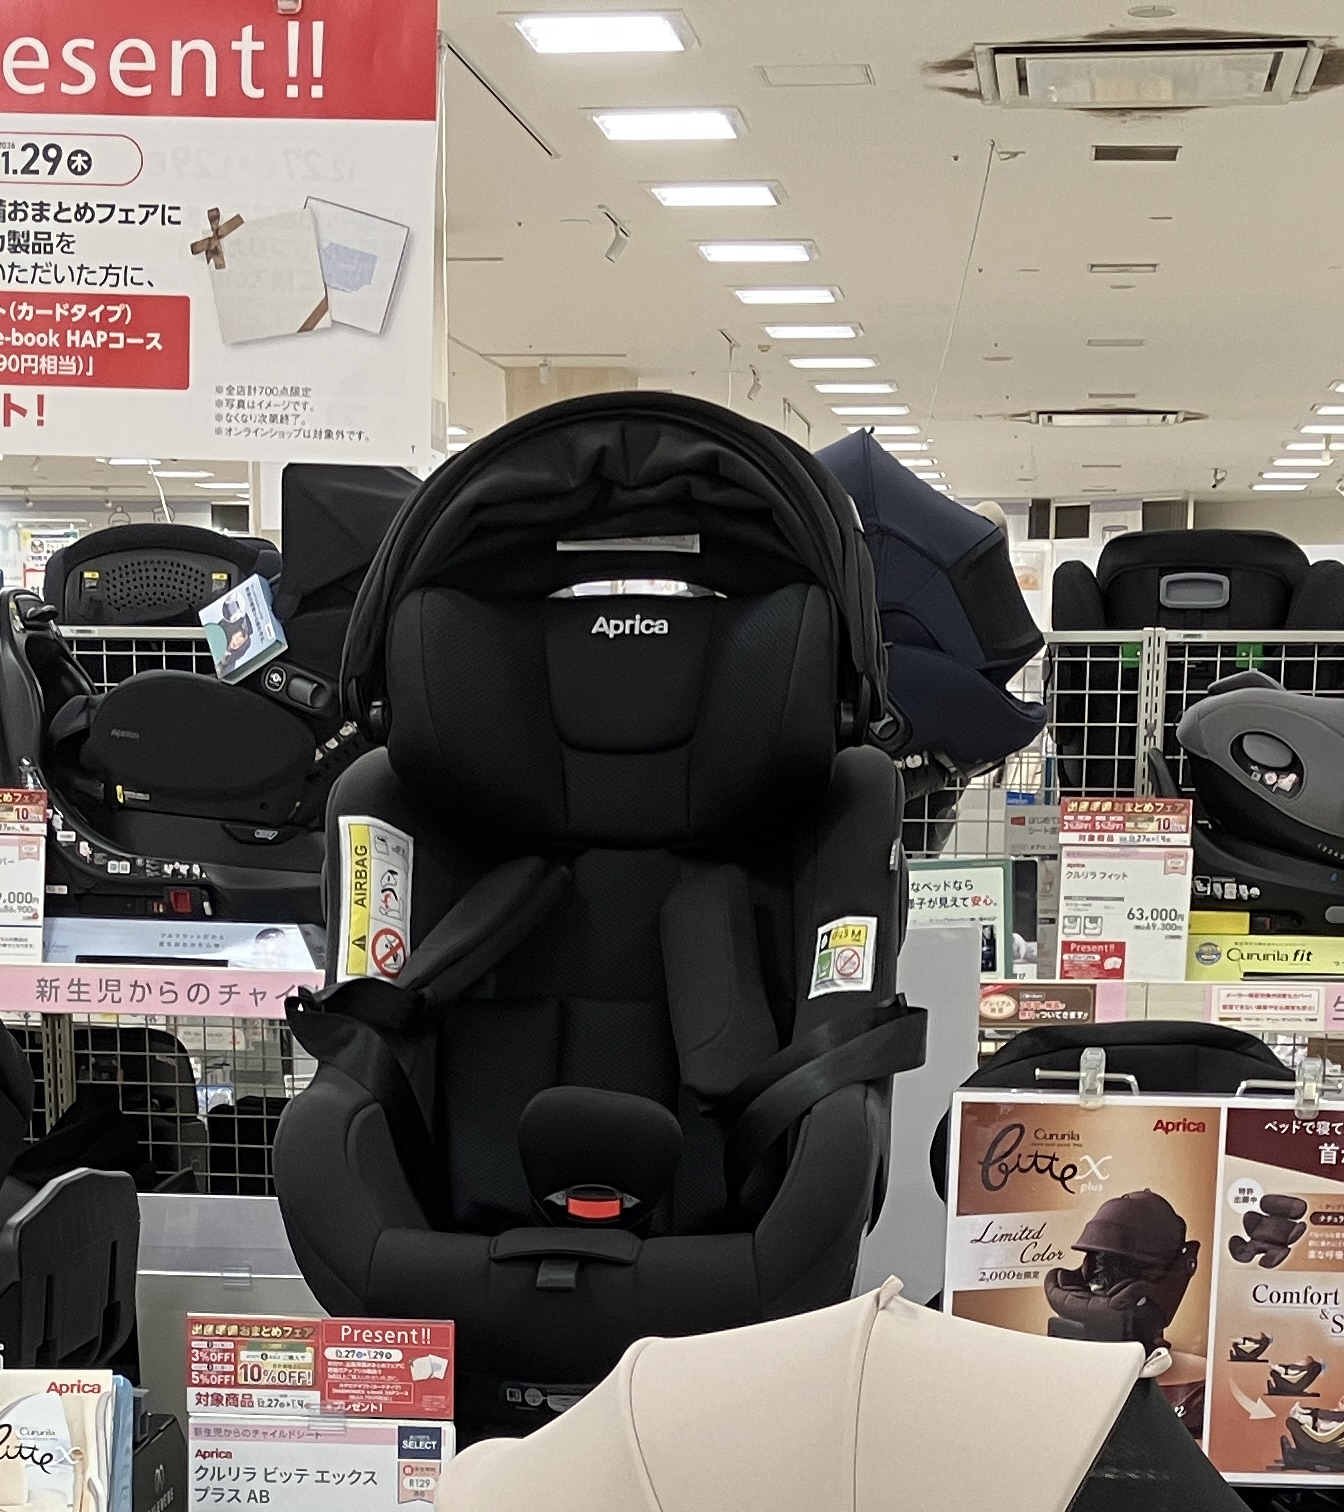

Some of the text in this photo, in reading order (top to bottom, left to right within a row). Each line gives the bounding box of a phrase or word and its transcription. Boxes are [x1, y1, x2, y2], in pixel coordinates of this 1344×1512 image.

[65, 328, 163, 352] HAPコース
[590, 613, 668, 639] Aprica
[351, 842, 370, 909] AIRBAG
[1065, 871, 1128, 880] クルリラ フィット
[1071, 942, 1115, 952] Present!!
[1226, 947, 1313, 963] Cururila fit
[35, 978, 319, 1008] 新生児からのチャイ
[1033, 1127, 1081, 1143] Cururila
[1152, 1119, 1206, 1135] Aprica
[1080, 1179, 1105, 1195] plus
[971, 1221, 1045, 1245] Limited
[1019, 1241, 1066, 1264] Color
[1252, 1284, 1340, 1306] Comfort
[341, 1325, 431, 1345] Present!!
[45, 1379, 103, 1396] Aprica
[195, 1447, 233, 1461] Aprica
[193, 1464, 378, 1487] クルリラ ビッテ エックス
